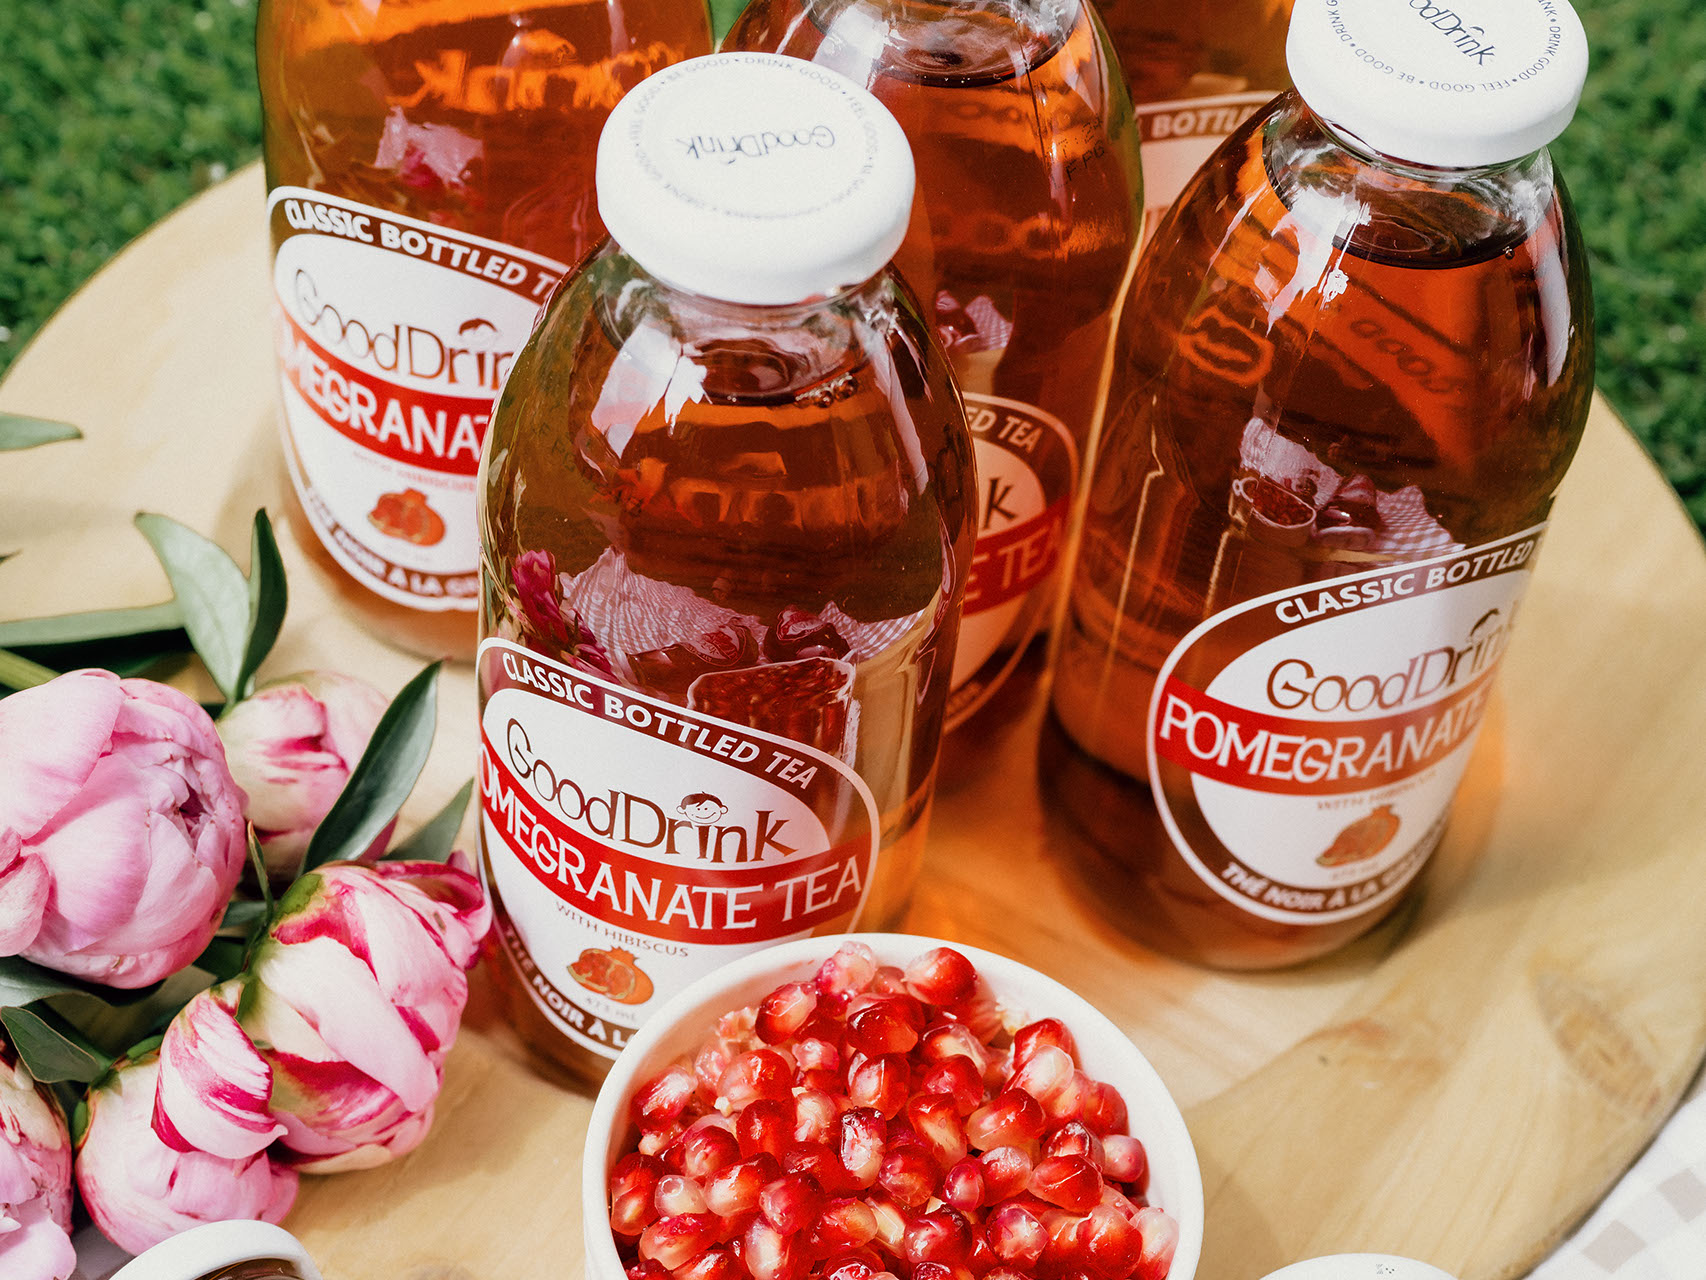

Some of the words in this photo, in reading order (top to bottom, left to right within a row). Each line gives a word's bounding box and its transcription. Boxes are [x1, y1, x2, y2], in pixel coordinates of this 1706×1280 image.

[1328, 10, 1352, 42] DRINK
[1409, 0, 1495, 66] odDrink
[1543, 26, 1560, 56] DRINK
[800, 67, 840, 90] GOOD
[1355, 48, 1394, 74] GOOD
[1397, 72, 1415, 83] BE
[1519, 57, 1550, 80] GOOD
[1429, 81, 1475, 92] GOOD
[1482, 80, 1511, 91] FEEL
[676, 125, 835, 160] GoodDrink
[284, 199, 374, 243] CLASSIC
[380, 222, 528, 286] BOTTLED
[296, 269, 514, 390] GoodDrin
[998, 415, 1043, 454] TEA
[1275, 573, 1415, 623] CLASSIC
[1425, 539, 1535, 589] BOTTLED
[502, 652, 594, 709] CLASSIC
[604, 693, 759, 763] BOTTLED
[764, 751, 818, 790] TEA
[507, 718, 799, 863] GoodDrink
[479, 742, 763, 931] OMEGRANATE
[774, 859, 862, 923] TEA
[556, 901, 598, 932] WITH
[604, 927, 689, 958] HIBISCUS
[532, 973, 585, 1030] NOIR
[612, 1029, 634, 1048] L
